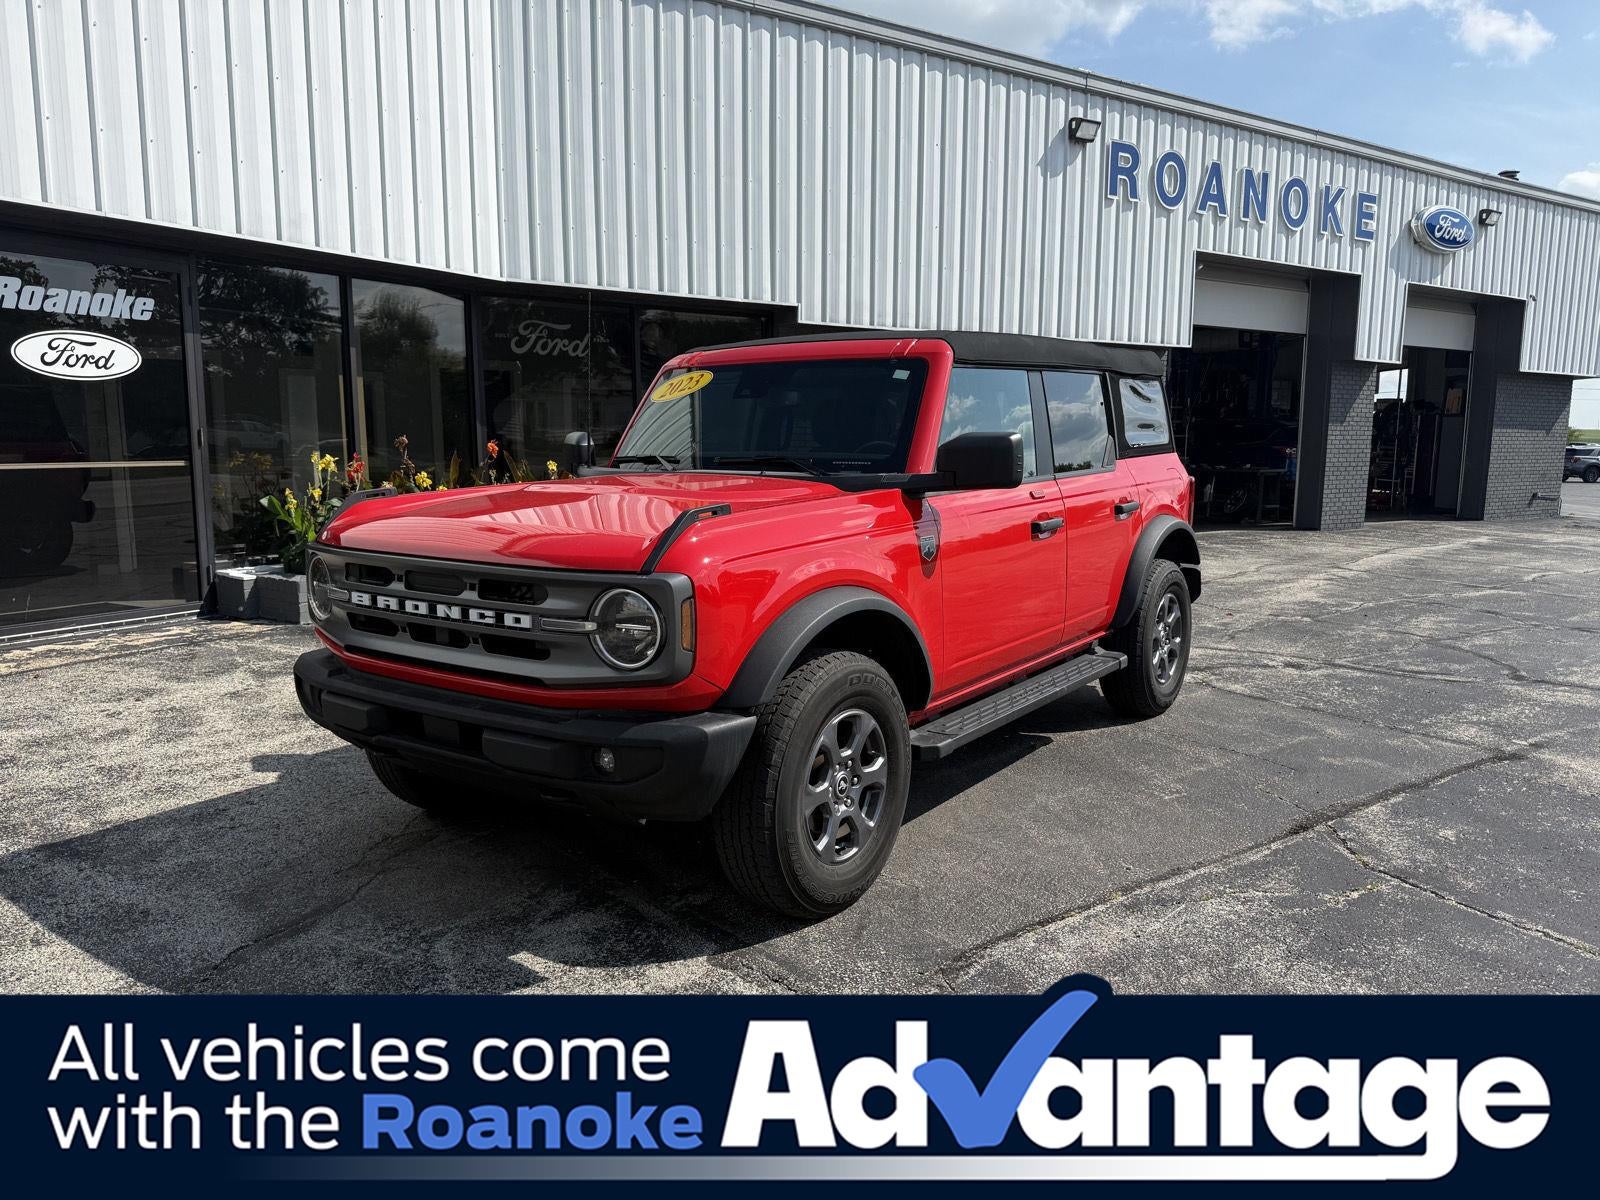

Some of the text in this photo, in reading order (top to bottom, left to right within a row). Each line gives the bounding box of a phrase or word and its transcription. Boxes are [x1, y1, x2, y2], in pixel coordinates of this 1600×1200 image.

[1106, 139, 1378, 243] ROANOKE
[1434, 214, 1467, 242] Ford
[0, 275, 155, 321] Roanoke
[40, 337, 115, 370] Ford
[511, 319, 589, 358] Ford
[657, 373, 705, 399] 2023
[351, 591, 533, 629] BRONCO
